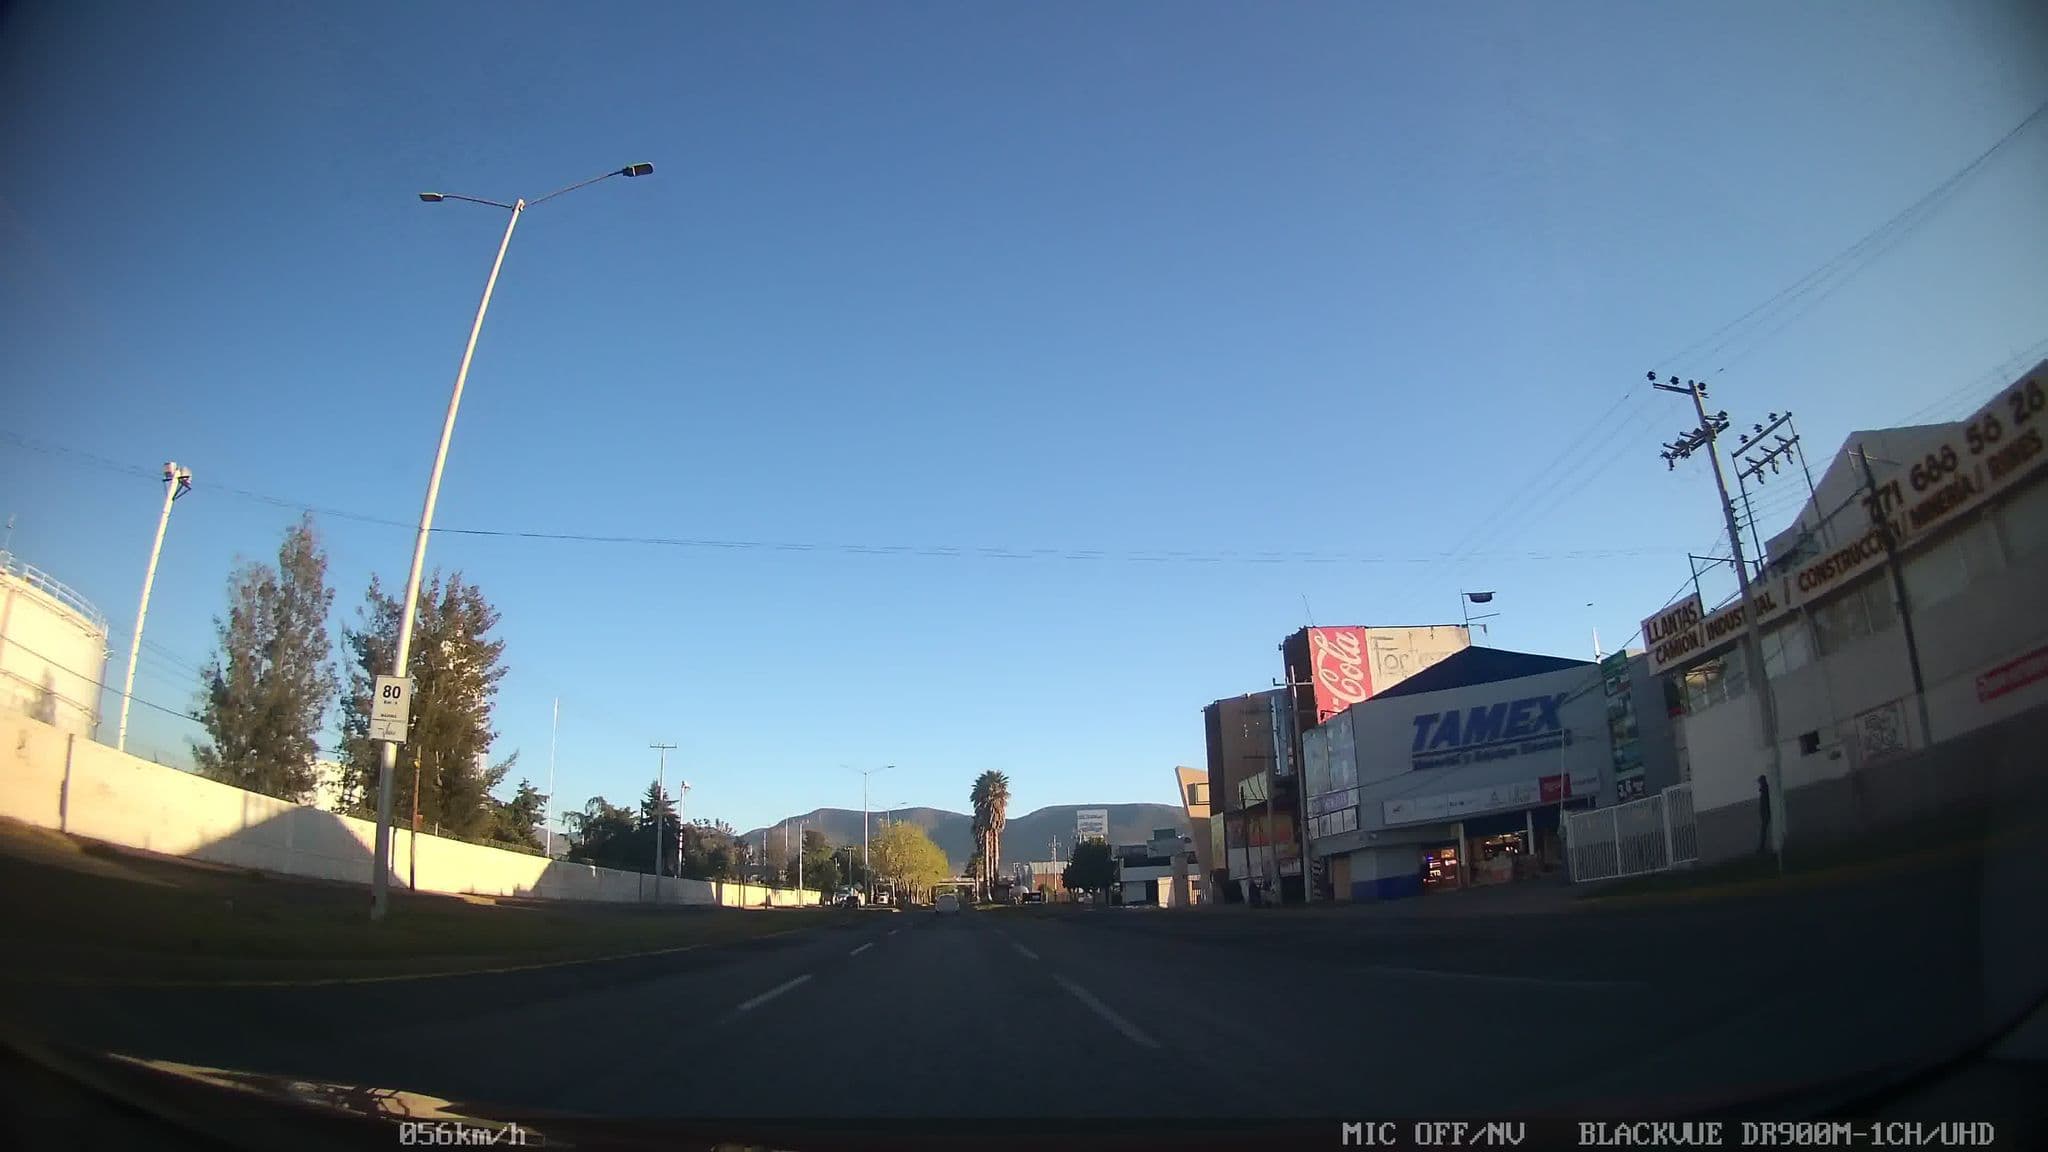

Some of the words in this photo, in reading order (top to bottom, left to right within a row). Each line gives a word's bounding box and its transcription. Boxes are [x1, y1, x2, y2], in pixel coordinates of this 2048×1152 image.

[1645, 602, 1698, 645] LLANTAS
[1705, 592, 1777, 641] INDUSTIAL
[382, 685, 401, 699] 80
[1412, 692, 1568, 752] TAMEX
